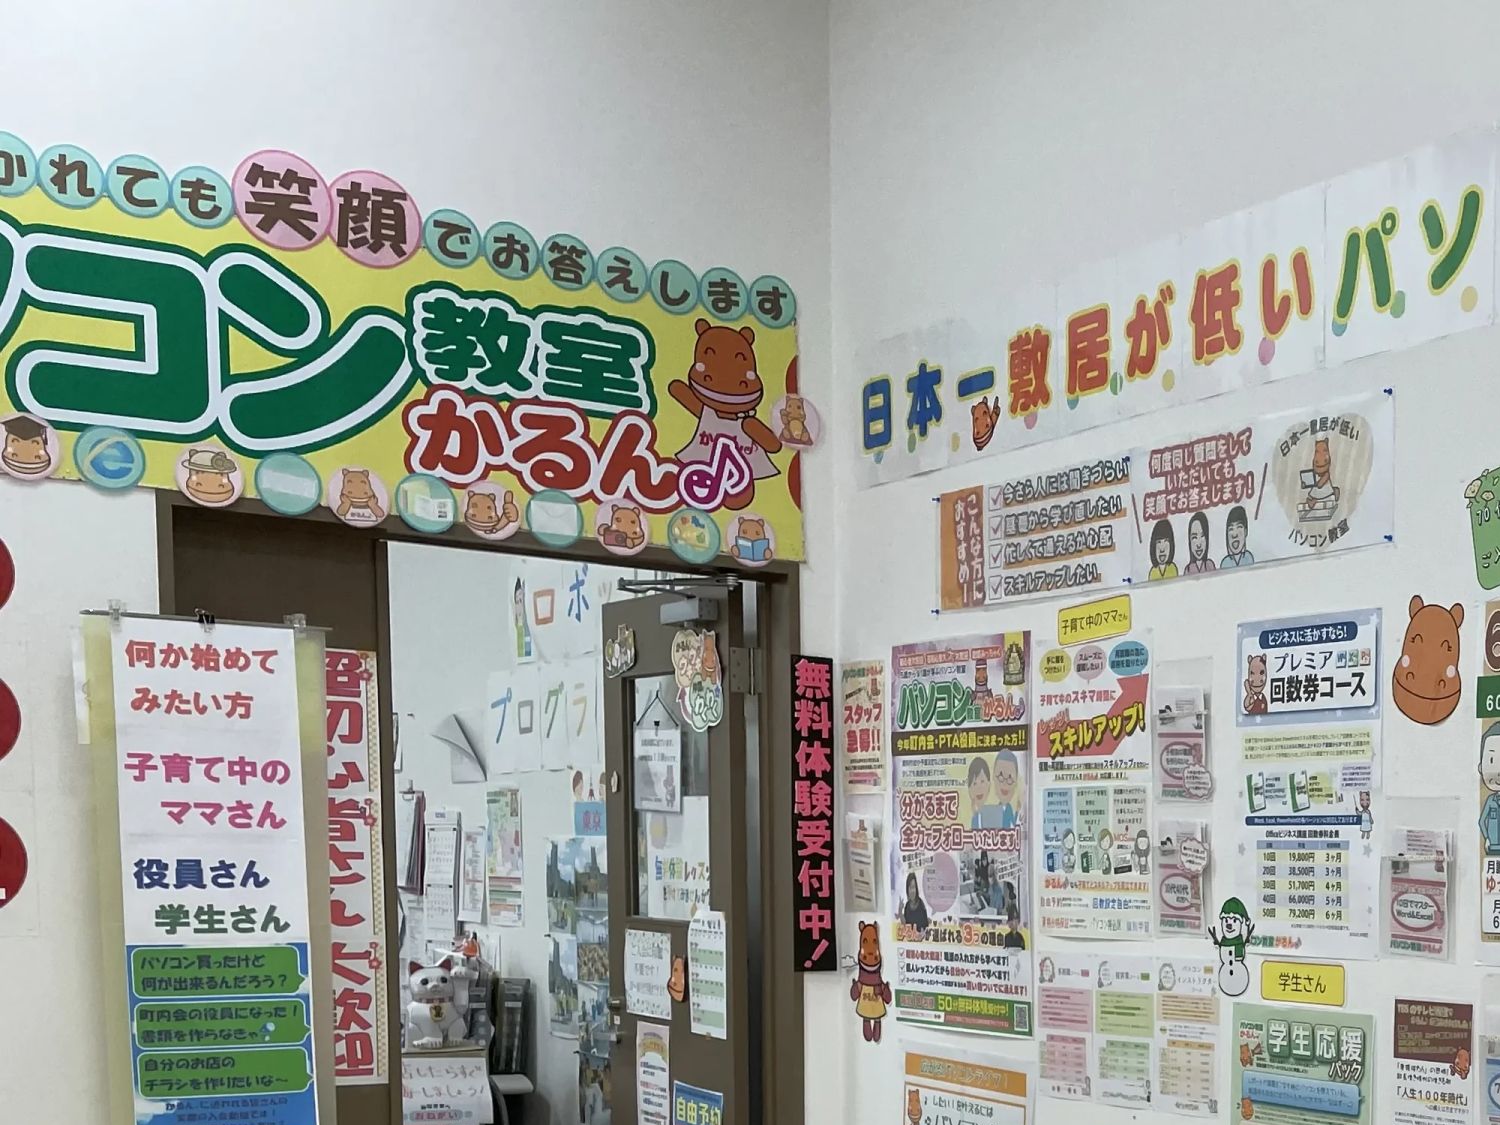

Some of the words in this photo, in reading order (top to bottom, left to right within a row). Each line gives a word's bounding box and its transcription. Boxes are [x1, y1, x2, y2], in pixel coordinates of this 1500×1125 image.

[125, 639, 279, 675] 何か始めて
[1273, 651, 1333, 674] プレミア
[130, 687, 254, 719] みたい方
[1269, 671, 1367, 704] 回数券コース
[124, 753, 291, 786] 子育て中の
[161, 800, 287, 830] ママさん
[133, 858, 270, 889] 役員さん
[155, 903, 291, 936] 学生さん
[1279, 972, 1327, 994] 学生さん
[1267, 1020, 1365, 1062] 学生応援
